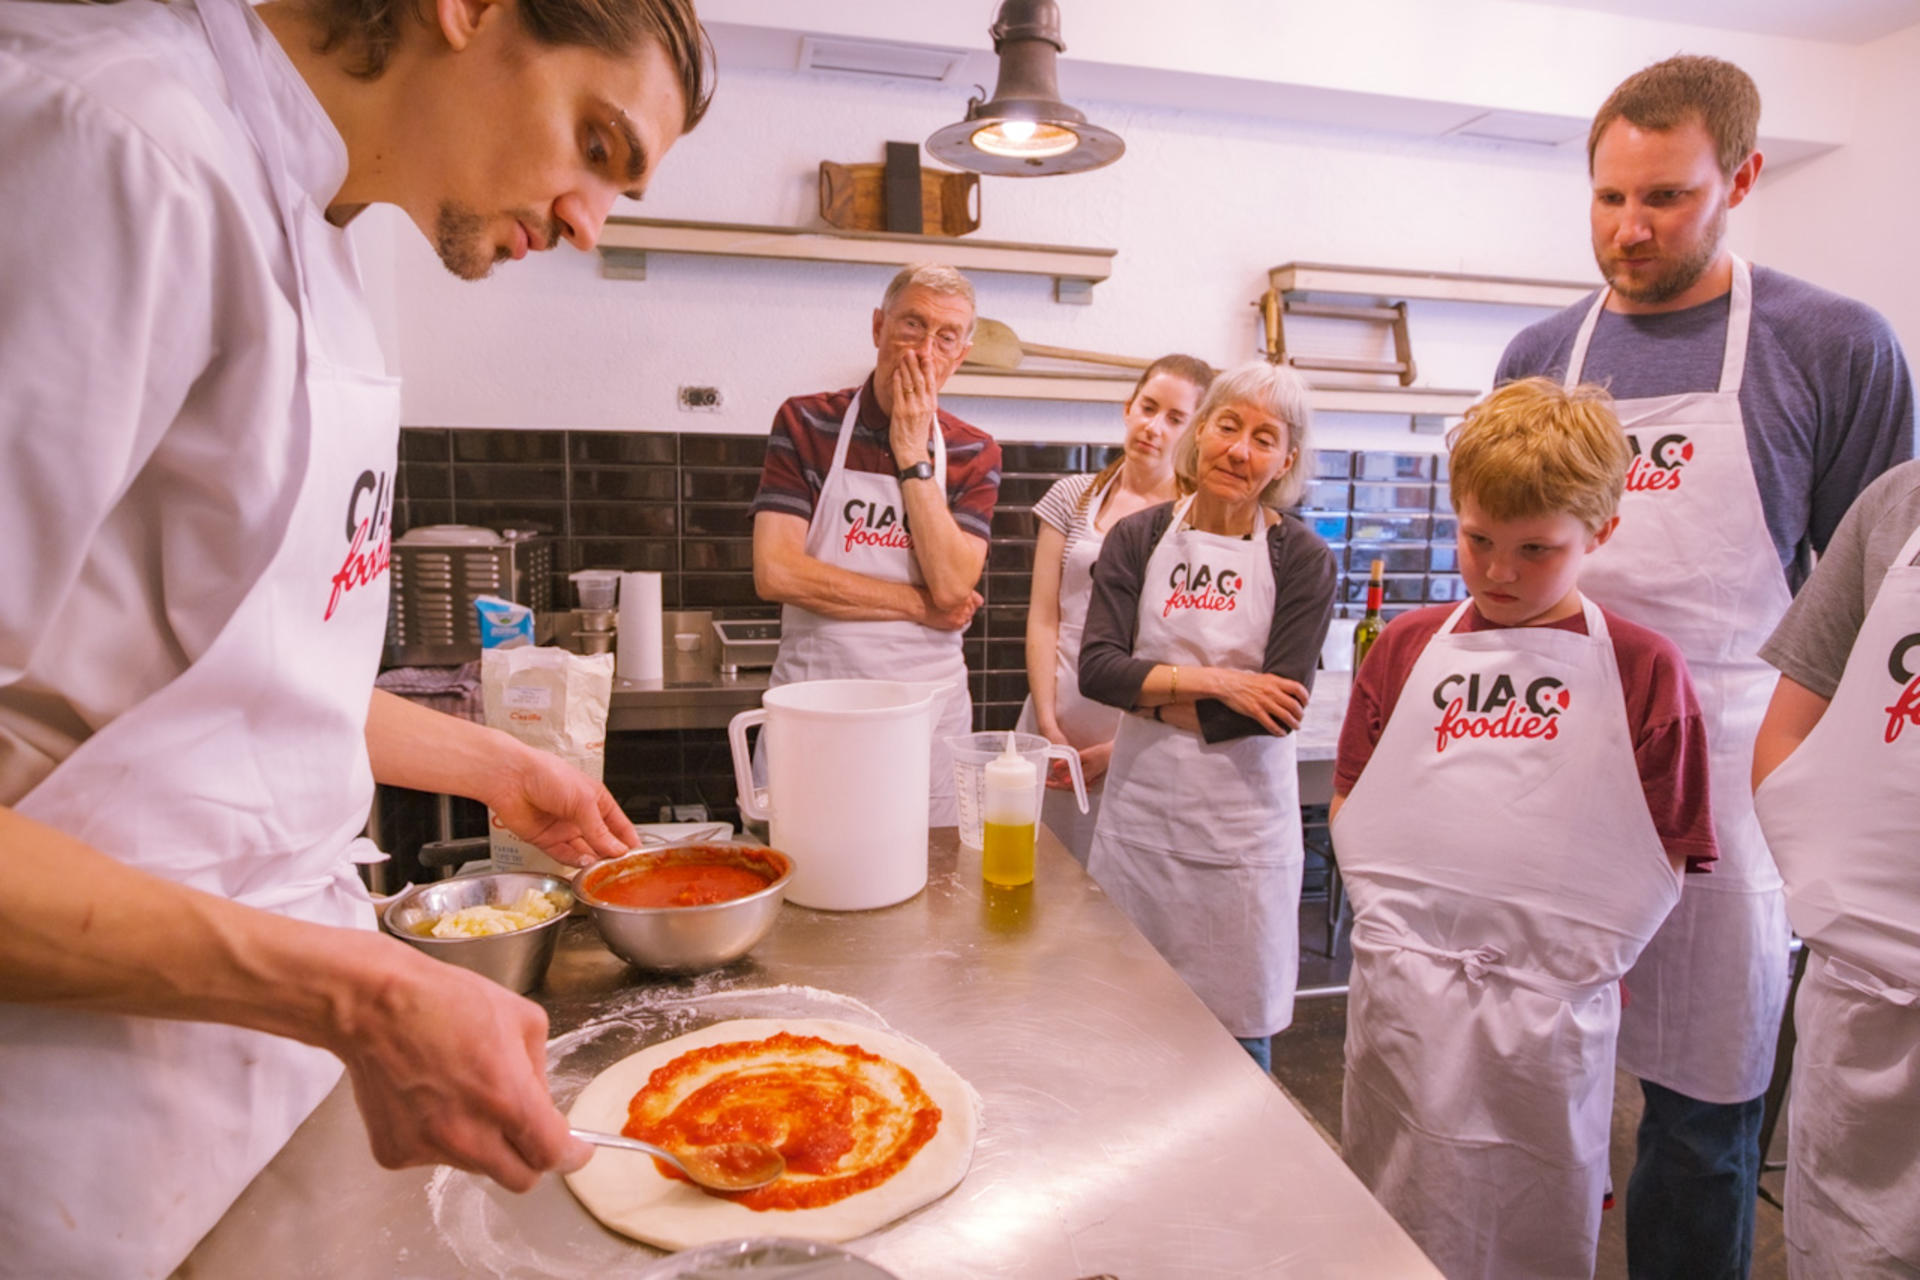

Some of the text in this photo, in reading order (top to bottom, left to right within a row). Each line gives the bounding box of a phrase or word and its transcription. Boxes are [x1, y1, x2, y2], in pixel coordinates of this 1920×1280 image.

[346, 469, 391, 543] CIA
[1163, 580, 1236, 618] foodies
[1169, 563, 1242, 597] CIAO
[1432, 673, 1570, 717] CIAO
[1433, 697, 1559, 753] foodies
